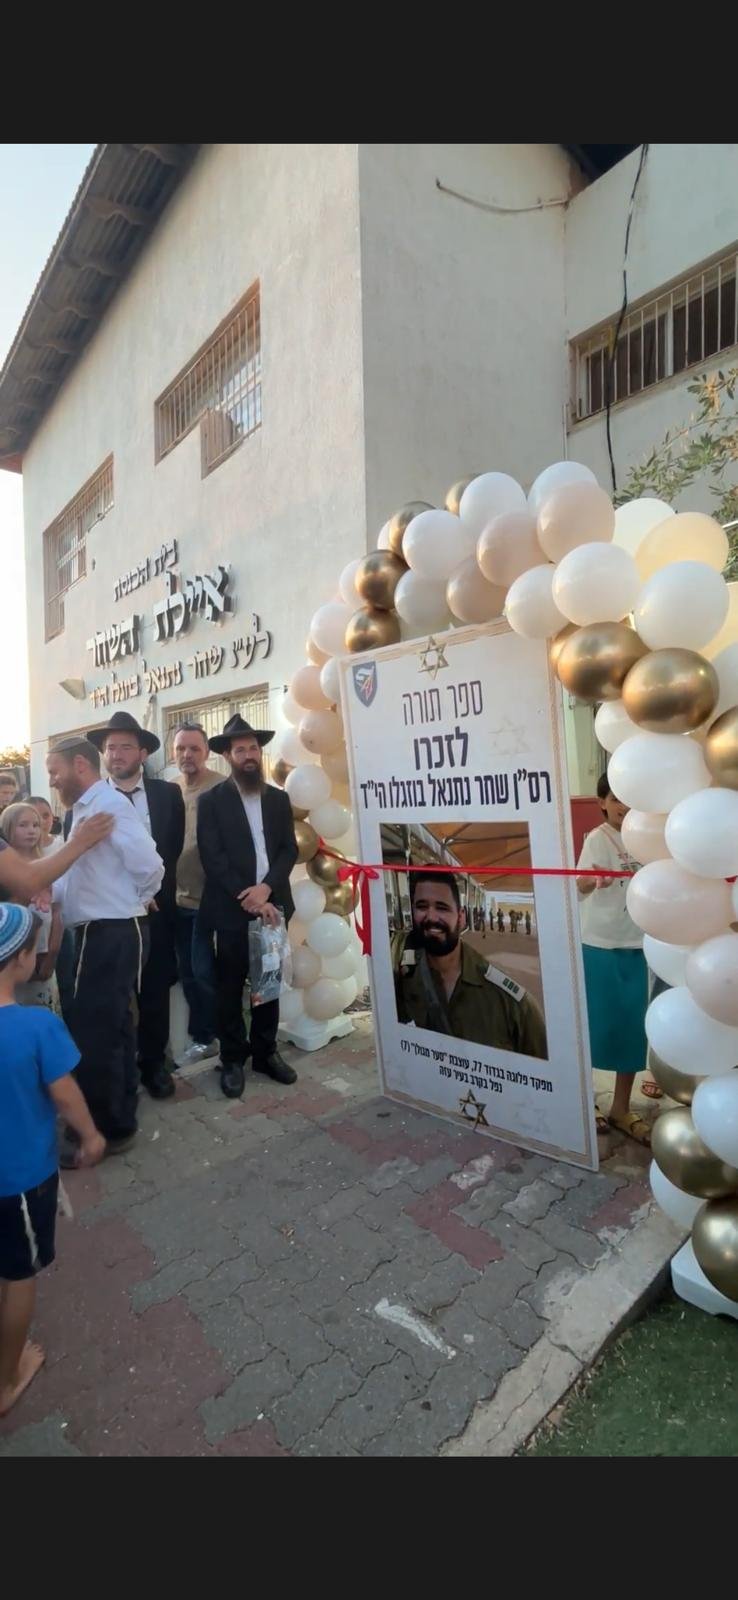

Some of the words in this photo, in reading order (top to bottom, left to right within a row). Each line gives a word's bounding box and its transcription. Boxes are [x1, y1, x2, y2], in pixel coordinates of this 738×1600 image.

[154, 539, 178, 576] בית
[114, 557, 150, 602] הכנסת
[86, 614, 141, 667] השחר
[143, 658, 183, 694] נתנאל
[187, 645, 224, 679] שחר
[402, 688, 441, 725] תורה
[447, 680, 483, 719] ספר
[413, 726, 469, 770] לזכרו
[360, 779, 387, 809] הי"ד
[389, 776, 426, 809] בוזגלו
[428, 773, 471, 807] נתנאל
[474, 773, 509, 805] שחר
[513, 768, 552, 810] רס"ן
[439, 1065, 452, 1078] עזה
[449, 1054, 470, 1069] עוצבת
[453, 1069, 469, 1083] בעיר
[471, 1060, 482, 1073] 77,
[484, 1064, 505, 1079] בגדוד
[469, 1074, 488, 1089] בקרב
[489, 1078, 503, 1093] נפל
[506, 1070, 528, 1086] פלוגה
[529, 1076, 553, 1092] מפקד
